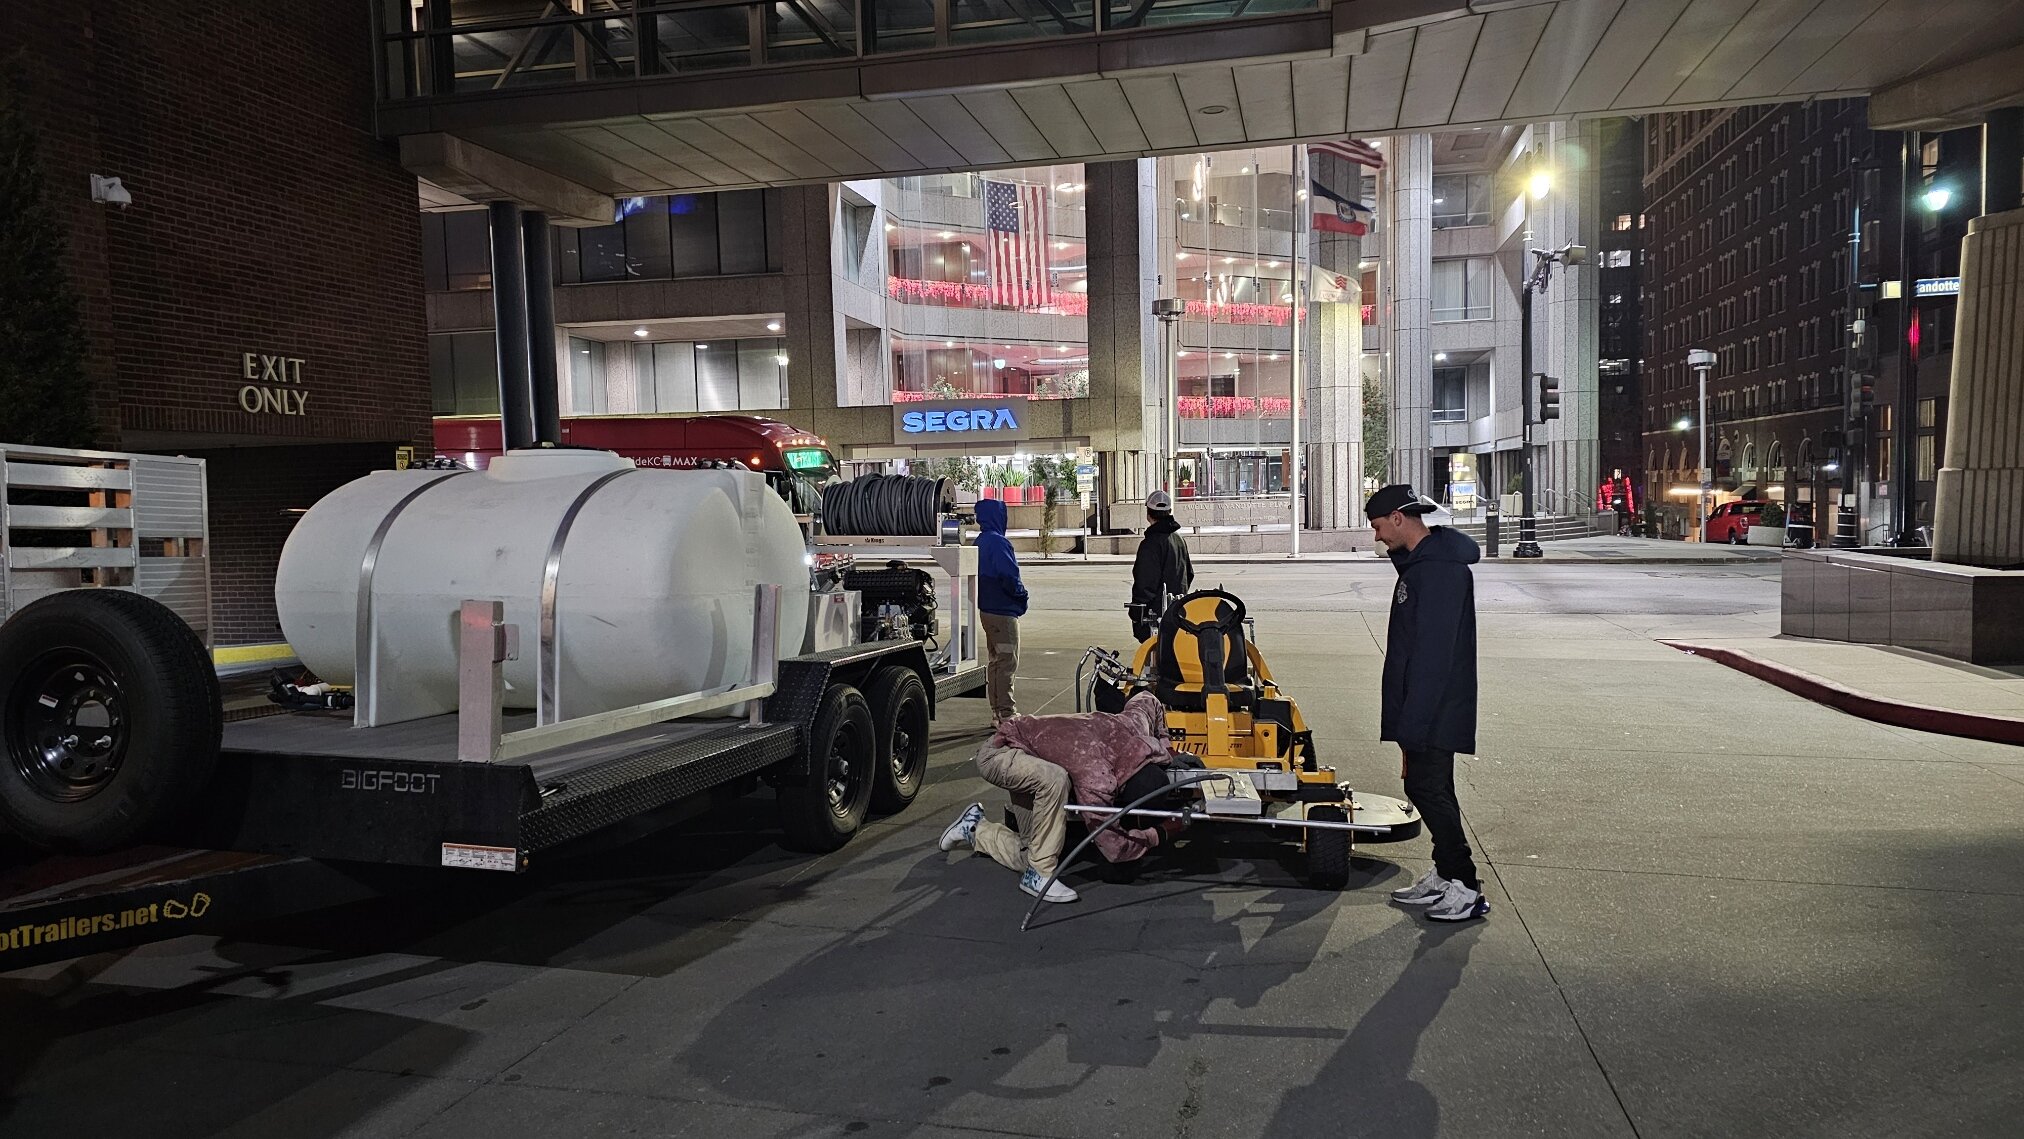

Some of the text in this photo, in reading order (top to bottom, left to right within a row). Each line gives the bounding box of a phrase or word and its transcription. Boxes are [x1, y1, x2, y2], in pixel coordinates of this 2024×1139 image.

[1919, 280, 1959, 293] andotte
[243, 353, 305, 384] EXIT
[239, 386, 309, 416] ONLY
[902, 408, 1018, 433] SEGRA
[633, 456, 698, 466] deKC MAX
[1269, 501, 1291, 509] PLAZ
[1176, 742, 1208, 755] ULTI
[341, 769, 441, 794] BIGFOOT
